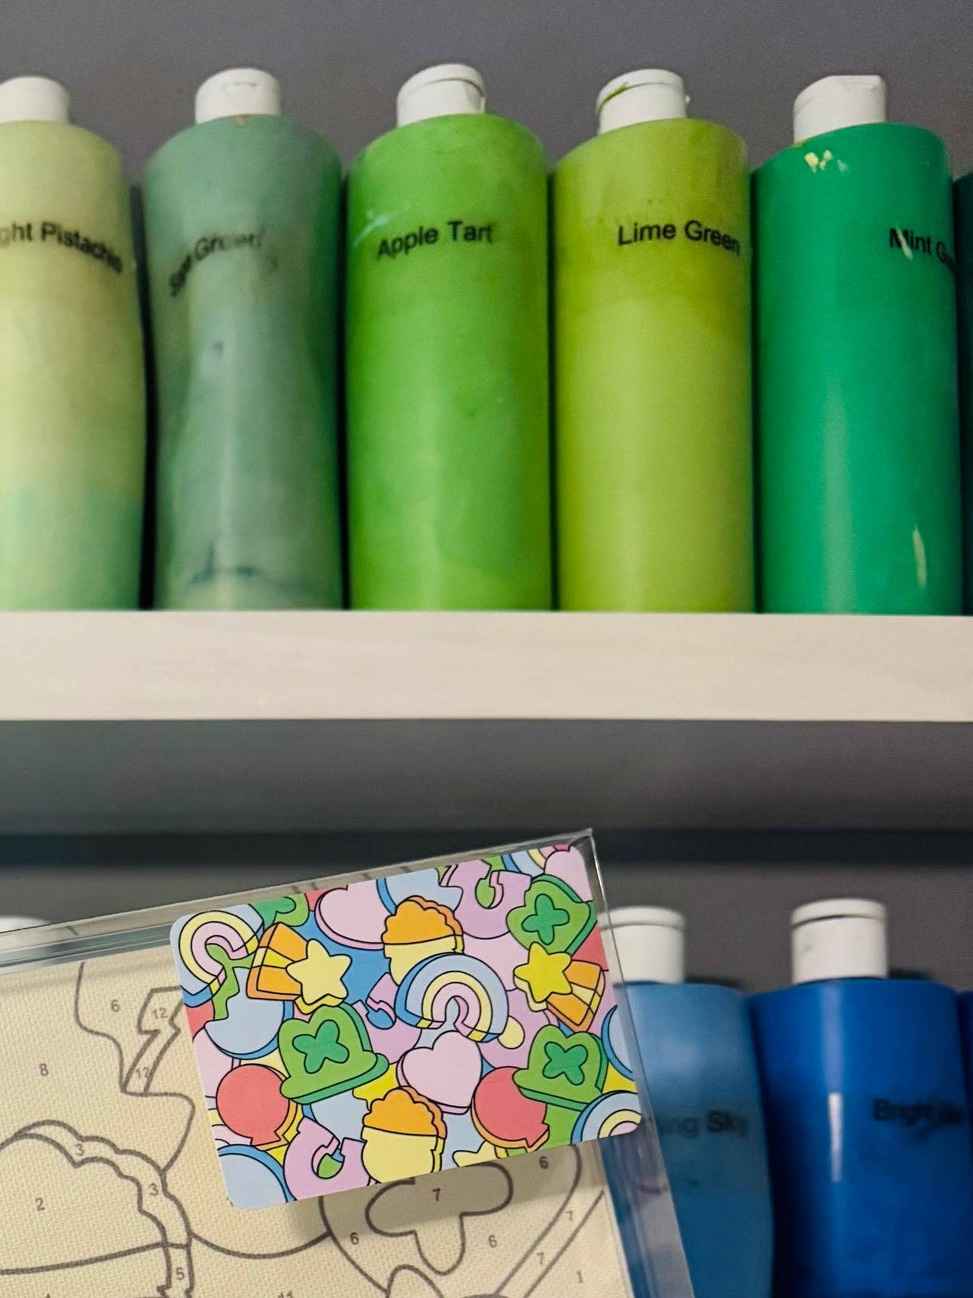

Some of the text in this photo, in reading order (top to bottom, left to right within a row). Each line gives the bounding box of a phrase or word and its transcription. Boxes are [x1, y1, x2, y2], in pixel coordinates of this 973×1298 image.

[376, 220, 494, 260] Apple Tart
[618, 220, 740, 258] Lime Green
[889, 228, 932, 255] Mint
[41, 221, 123, 275] Pistachio
[111, 999, 120, 1012] 6
[40, 1063, 49, 1076] 8
[539, 1156, 548, 1169] 6
[149, 1183, 158, 1196] 3
[433, 1188, 441, 1201] 7
[36, 1197, 45, 1211] 2
[488, 1234, 497, 1247] 6
[176, 1267, 185, 1281] 5
